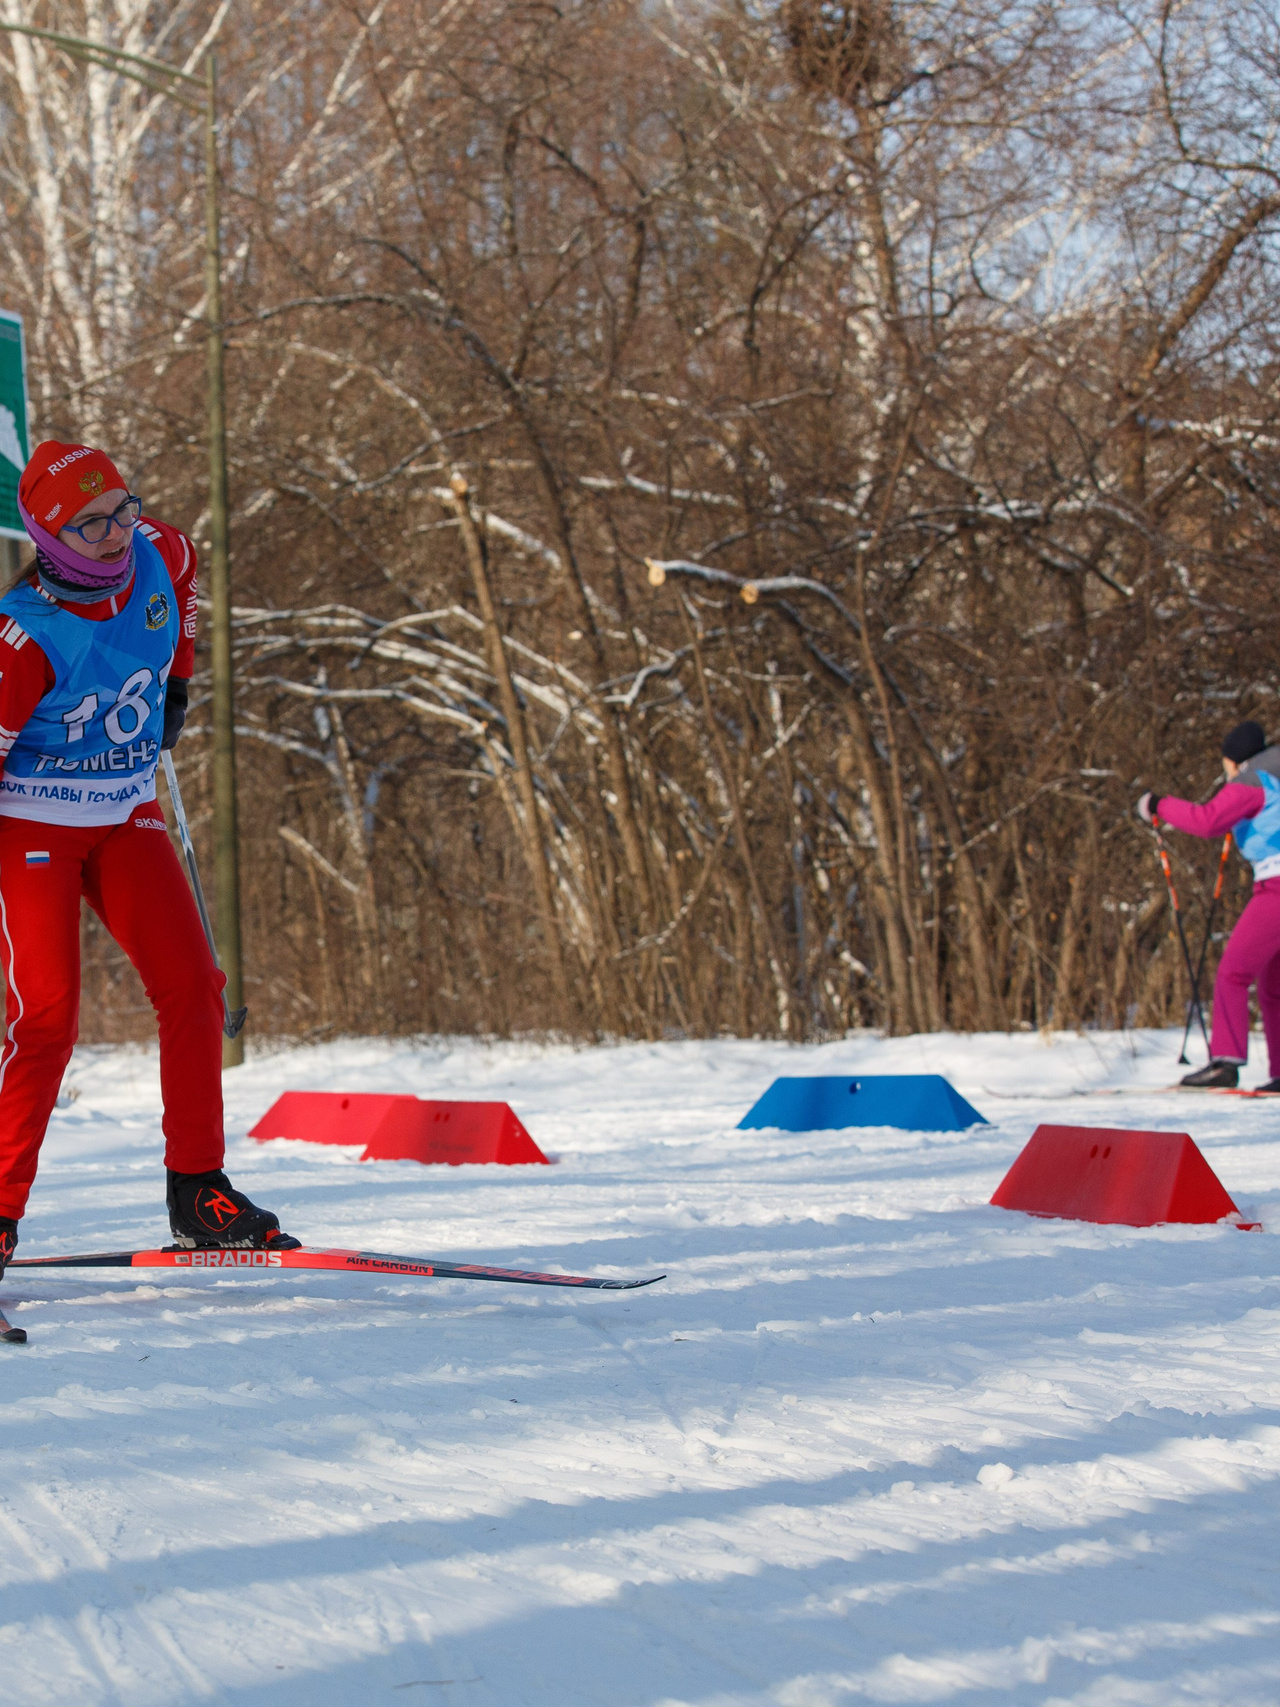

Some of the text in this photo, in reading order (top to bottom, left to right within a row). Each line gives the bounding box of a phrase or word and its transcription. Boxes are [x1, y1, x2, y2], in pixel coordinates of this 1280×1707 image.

[47, 448, 95, 476] RUSSIA
[31, 785, 83, 803] ГЛАВЫ
[191, 1250, 283, 1268] BRADOS
[346, 1256, 370, 1266] AIR
[371, 1259, 430, 1274] CARBON
